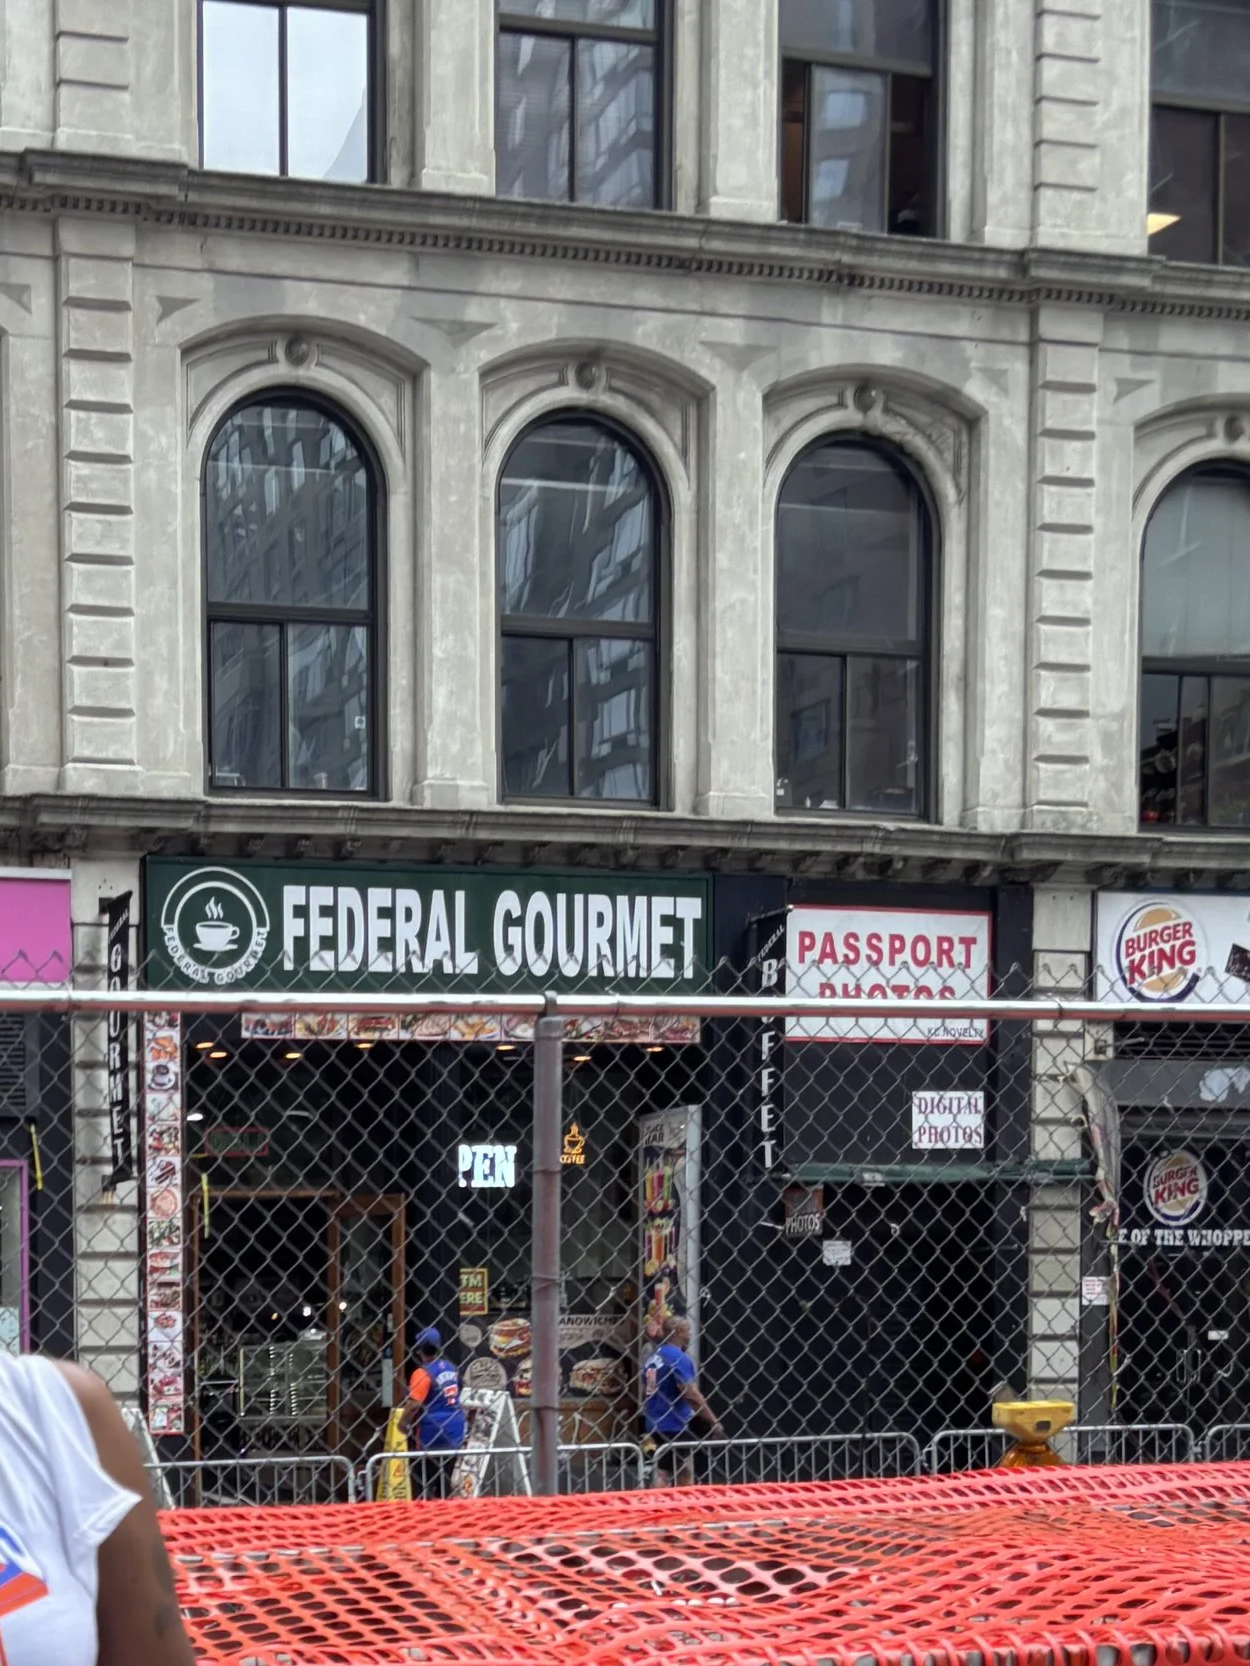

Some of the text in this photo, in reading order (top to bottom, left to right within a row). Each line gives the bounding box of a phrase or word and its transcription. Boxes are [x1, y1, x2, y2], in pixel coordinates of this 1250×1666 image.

[283, 885, 703, 980] FEDERAL GOURMET
[797, 930, 978, 969] PASSPORT
[1124, 920, 1197, 985] BURGER KING
[162, 925, 210, 984] FEDERAL
[761, 958, 779, 1168] BFFET
[918, 1096, 982, 1115] DIGITAL
[918, 1125, 983, 1144] PHOTOS
[458, 1144, 518, 1188] PEN
[1152, 1165, 1200, 1206] BURGER KING
[786, 1212, 821, 1235] PHOTOS
[1130, 1229, 1150, 1246] OF
[1154, 1229, 1184, 1246] THE
[1187, 1229, 1250, 1247] WHOPPE
[460, 1291, 483, 1305] ERE
